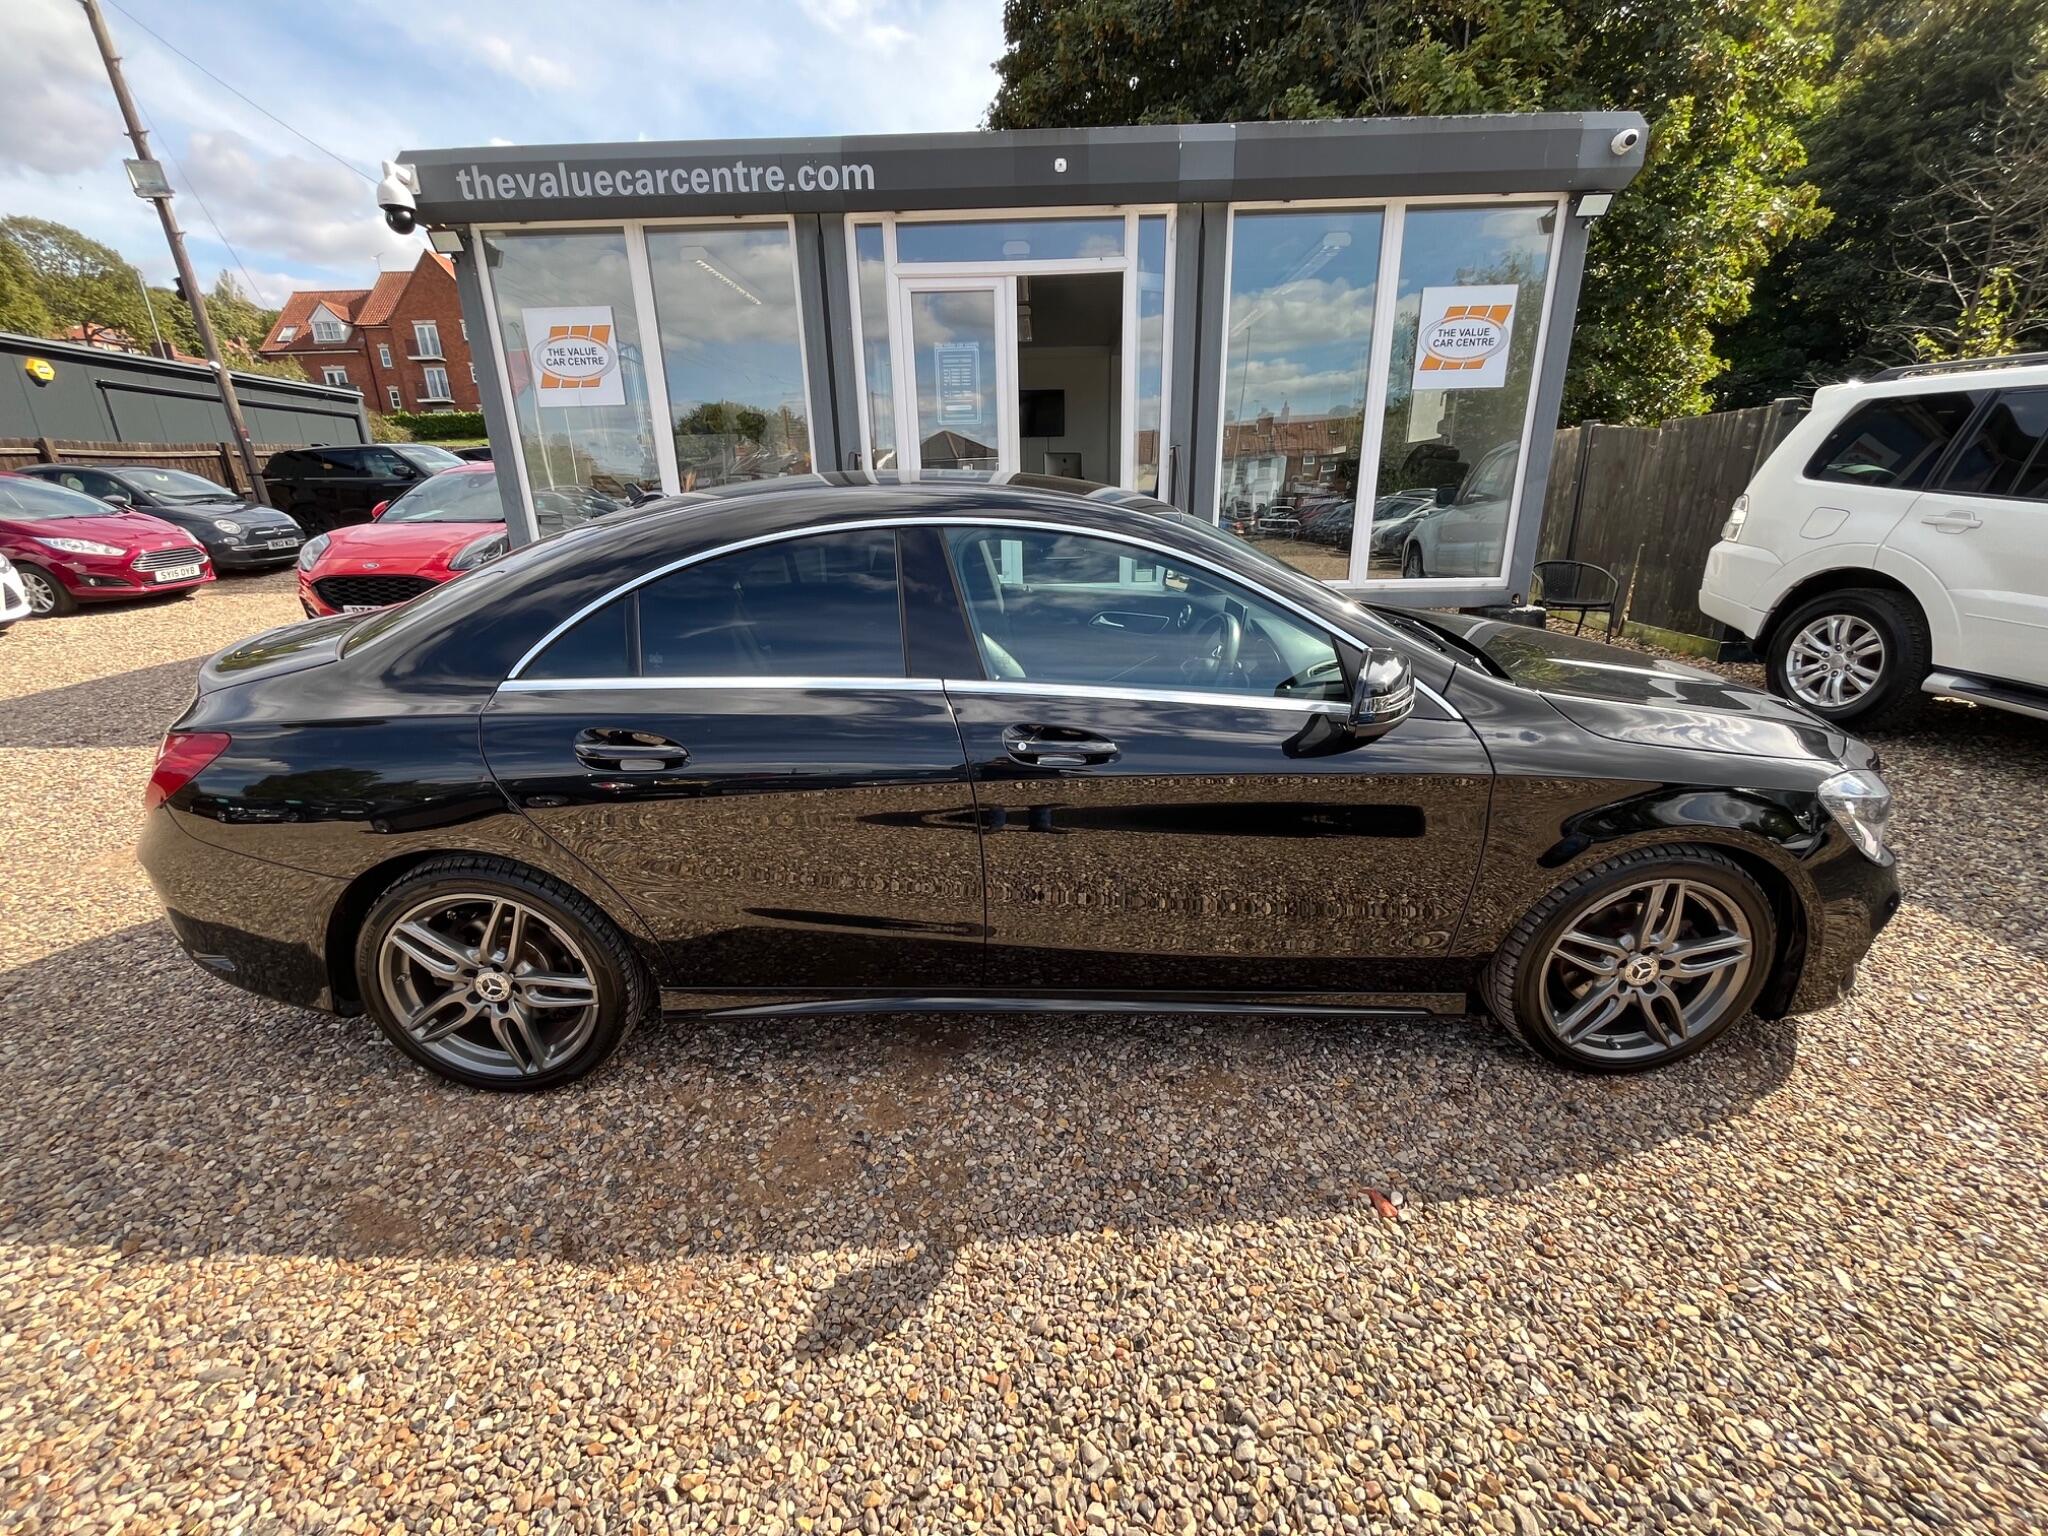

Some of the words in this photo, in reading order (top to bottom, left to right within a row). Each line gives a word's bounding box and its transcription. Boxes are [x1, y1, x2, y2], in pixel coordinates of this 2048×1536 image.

[456, 160, 876, 201] thevaluecarcentre.com
[1438, 328, 1456, 337] THE
[1459, 327, 1490, 337] VALUE
[1433, 338, 1453, 348] CAR
[1456, 337, 1495, 347] CENTRE
[547, 348, 565, 356] THE
[567, 347, 597, 356] VALUE
[546, 358, 566, 367] CAR
[567, 357, 604, 366] CENTRE
[160, 570, 179, 579] SY15
